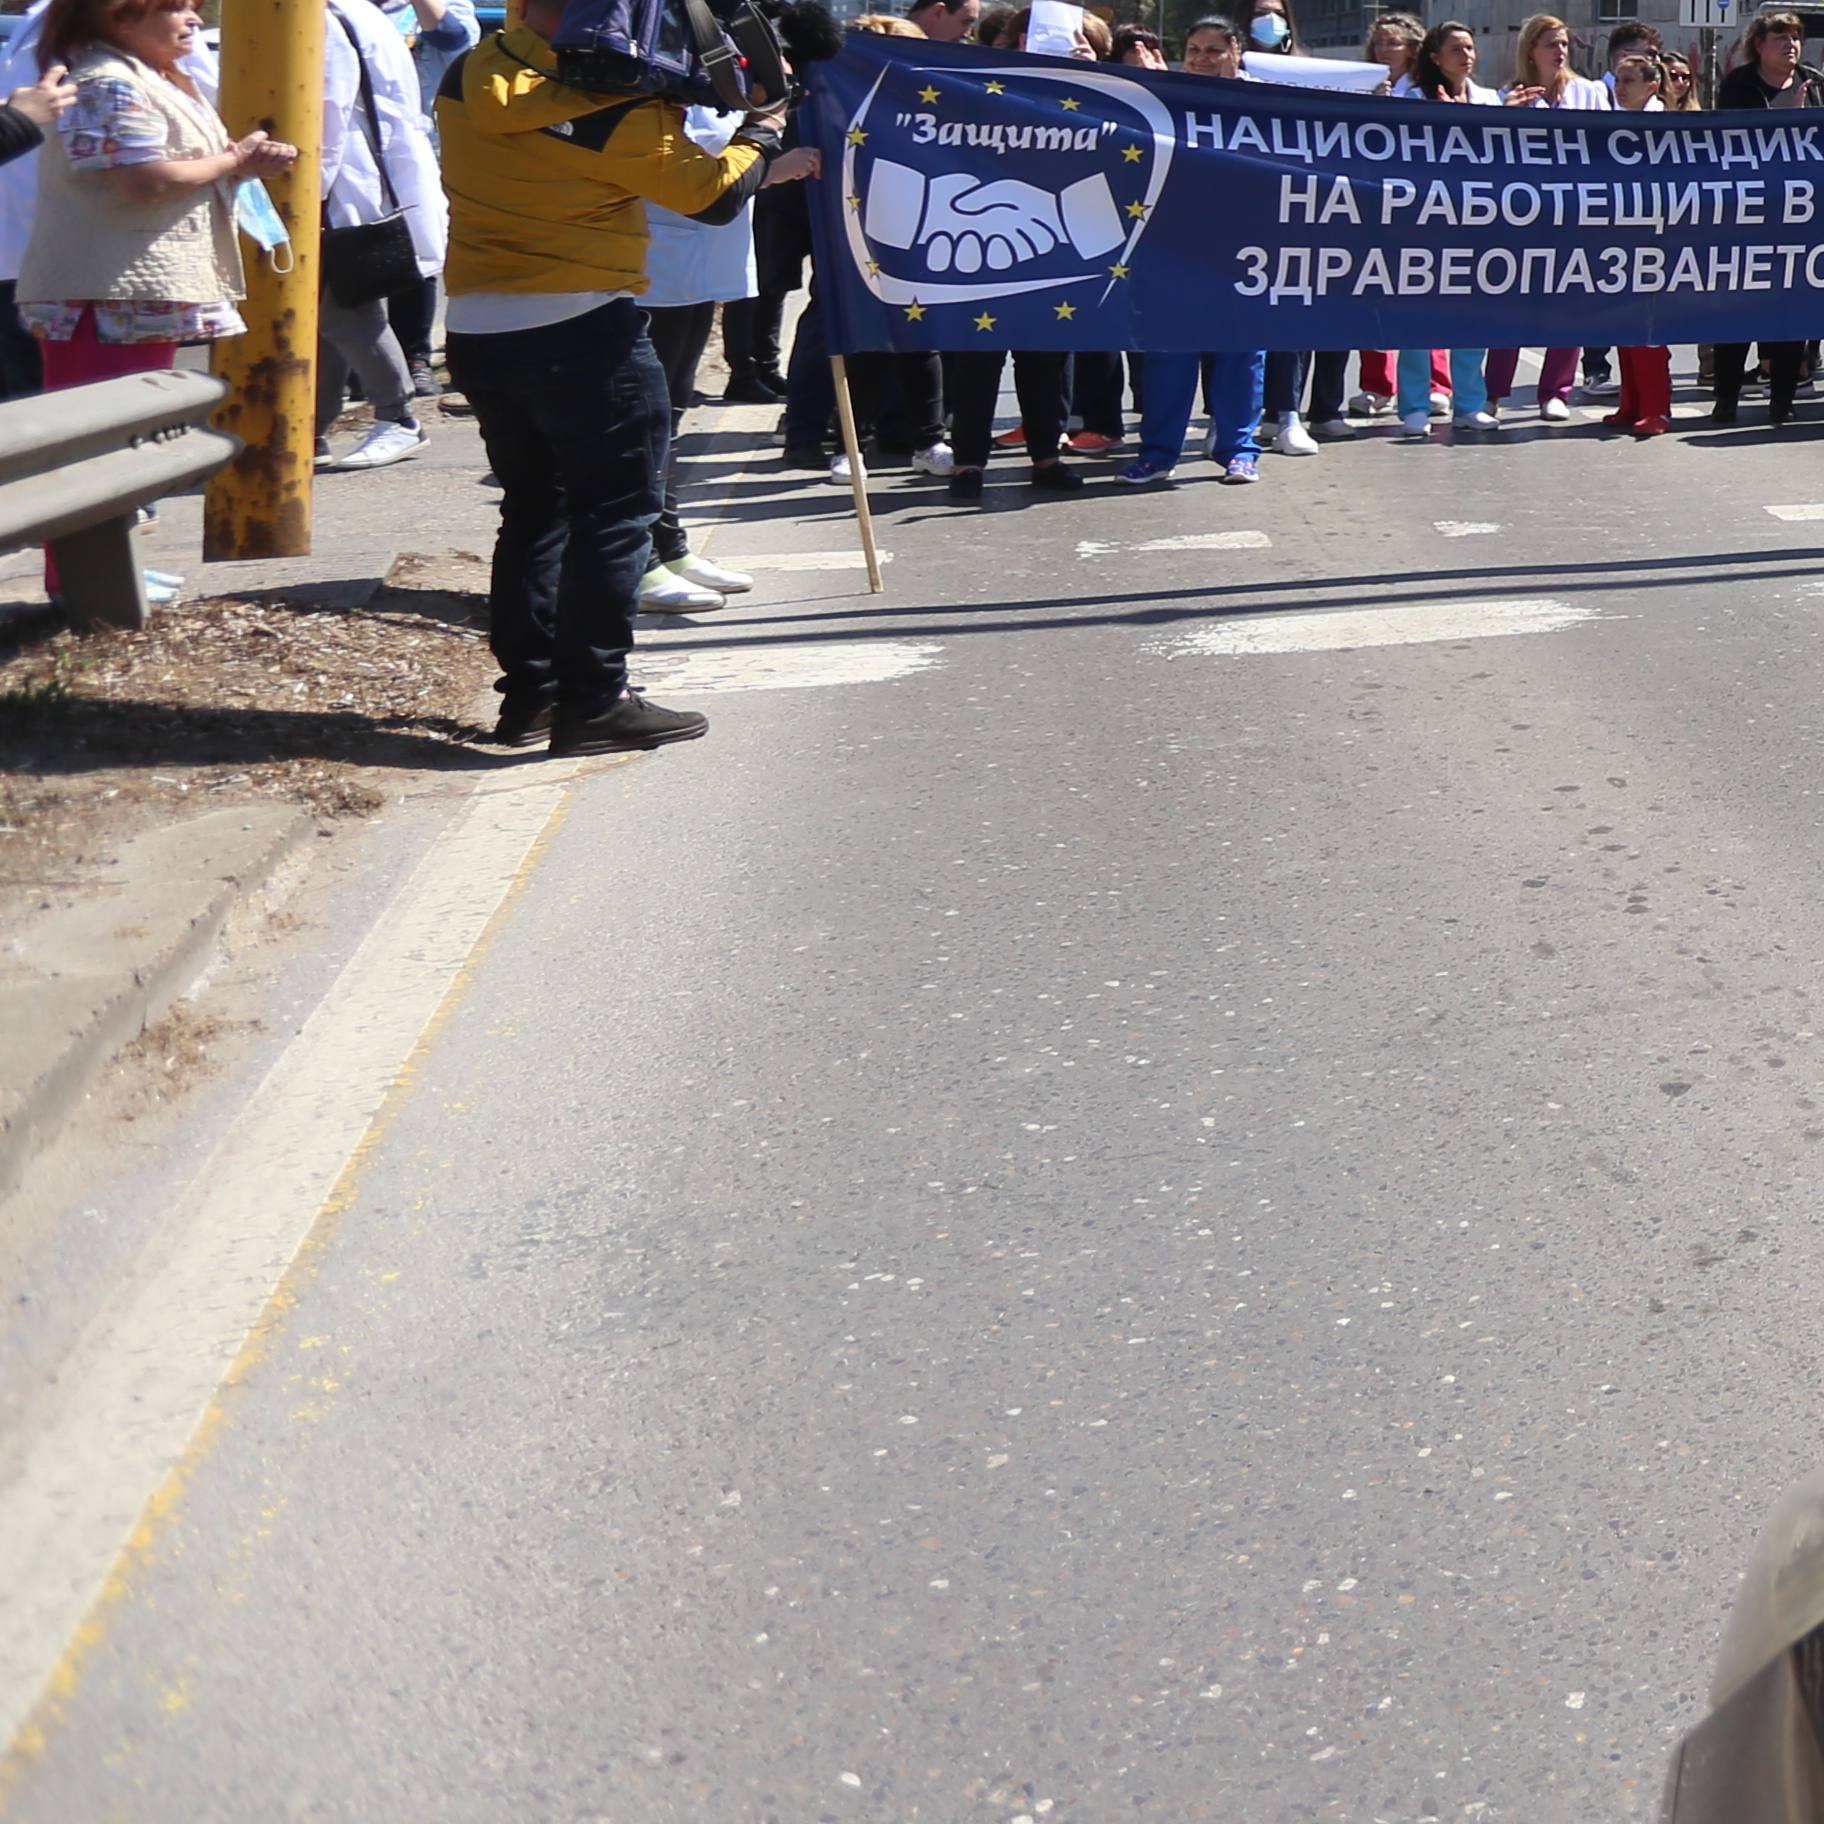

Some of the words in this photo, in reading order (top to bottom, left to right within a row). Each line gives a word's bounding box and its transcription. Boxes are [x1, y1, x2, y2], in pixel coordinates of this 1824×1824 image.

[1186, 111, 1587, 167] НАЦИОНАЛЕН
[1279, 174, 1362, 225] НА
[1381, 179, 1765, 235] РАБОТЕЩИТЕ
[1783, 180, 1815, 224] В
